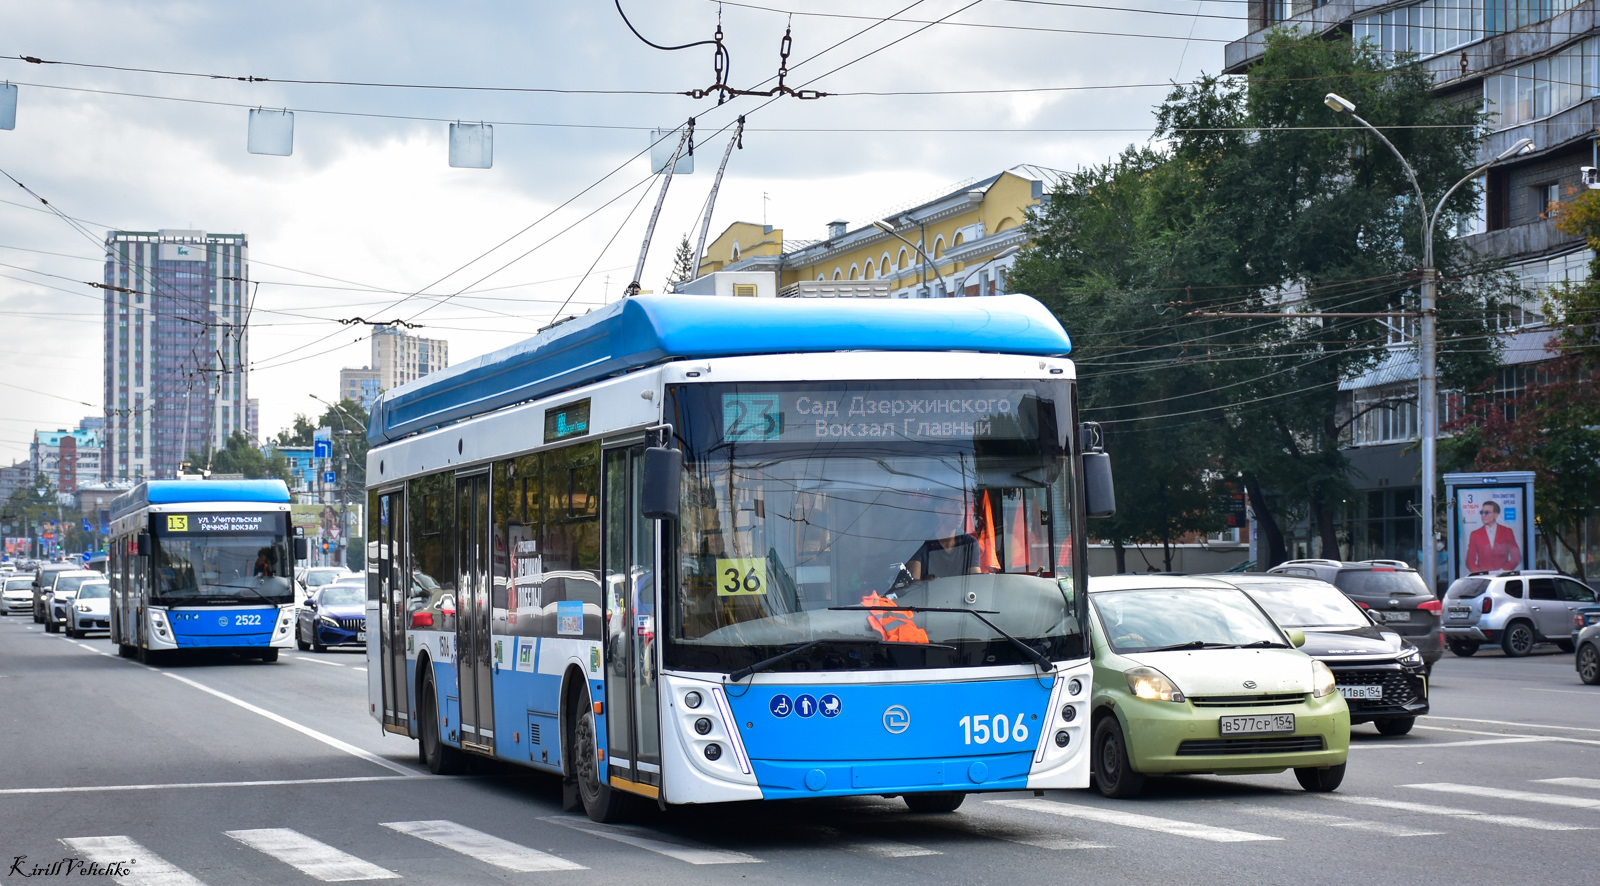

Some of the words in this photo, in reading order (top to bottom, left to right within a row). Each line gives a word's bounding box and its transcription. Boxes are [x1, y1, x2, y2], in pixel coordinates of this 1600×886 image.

[724, 400, 777, 437] 23
[796, 396, 839, 417] Сад
[848, 396, 1011, 419] Дзержинского
[815, 418, 895, 438] Вокзал
[904, 417, 992, 437] Главный
[1468, 494, 1474, 504] 3
[169, 517, 186, 530] 13
[212, 515, 263, 523] Учительская
[201, 523, 229, 531] Речной
[724, 567, 761, 593] 36
[235, 614, 262, 626] 2522
[439, 636, 449, 657] 1506
[1336, 687, 1365, 698] 11ВВ
[1366, 686, 1380, 695] 154
[959, 713, 1029, 745] 1506
[1225, 717, 1271, 732] В577СР
[1273, 715, 1293, 726] 154
